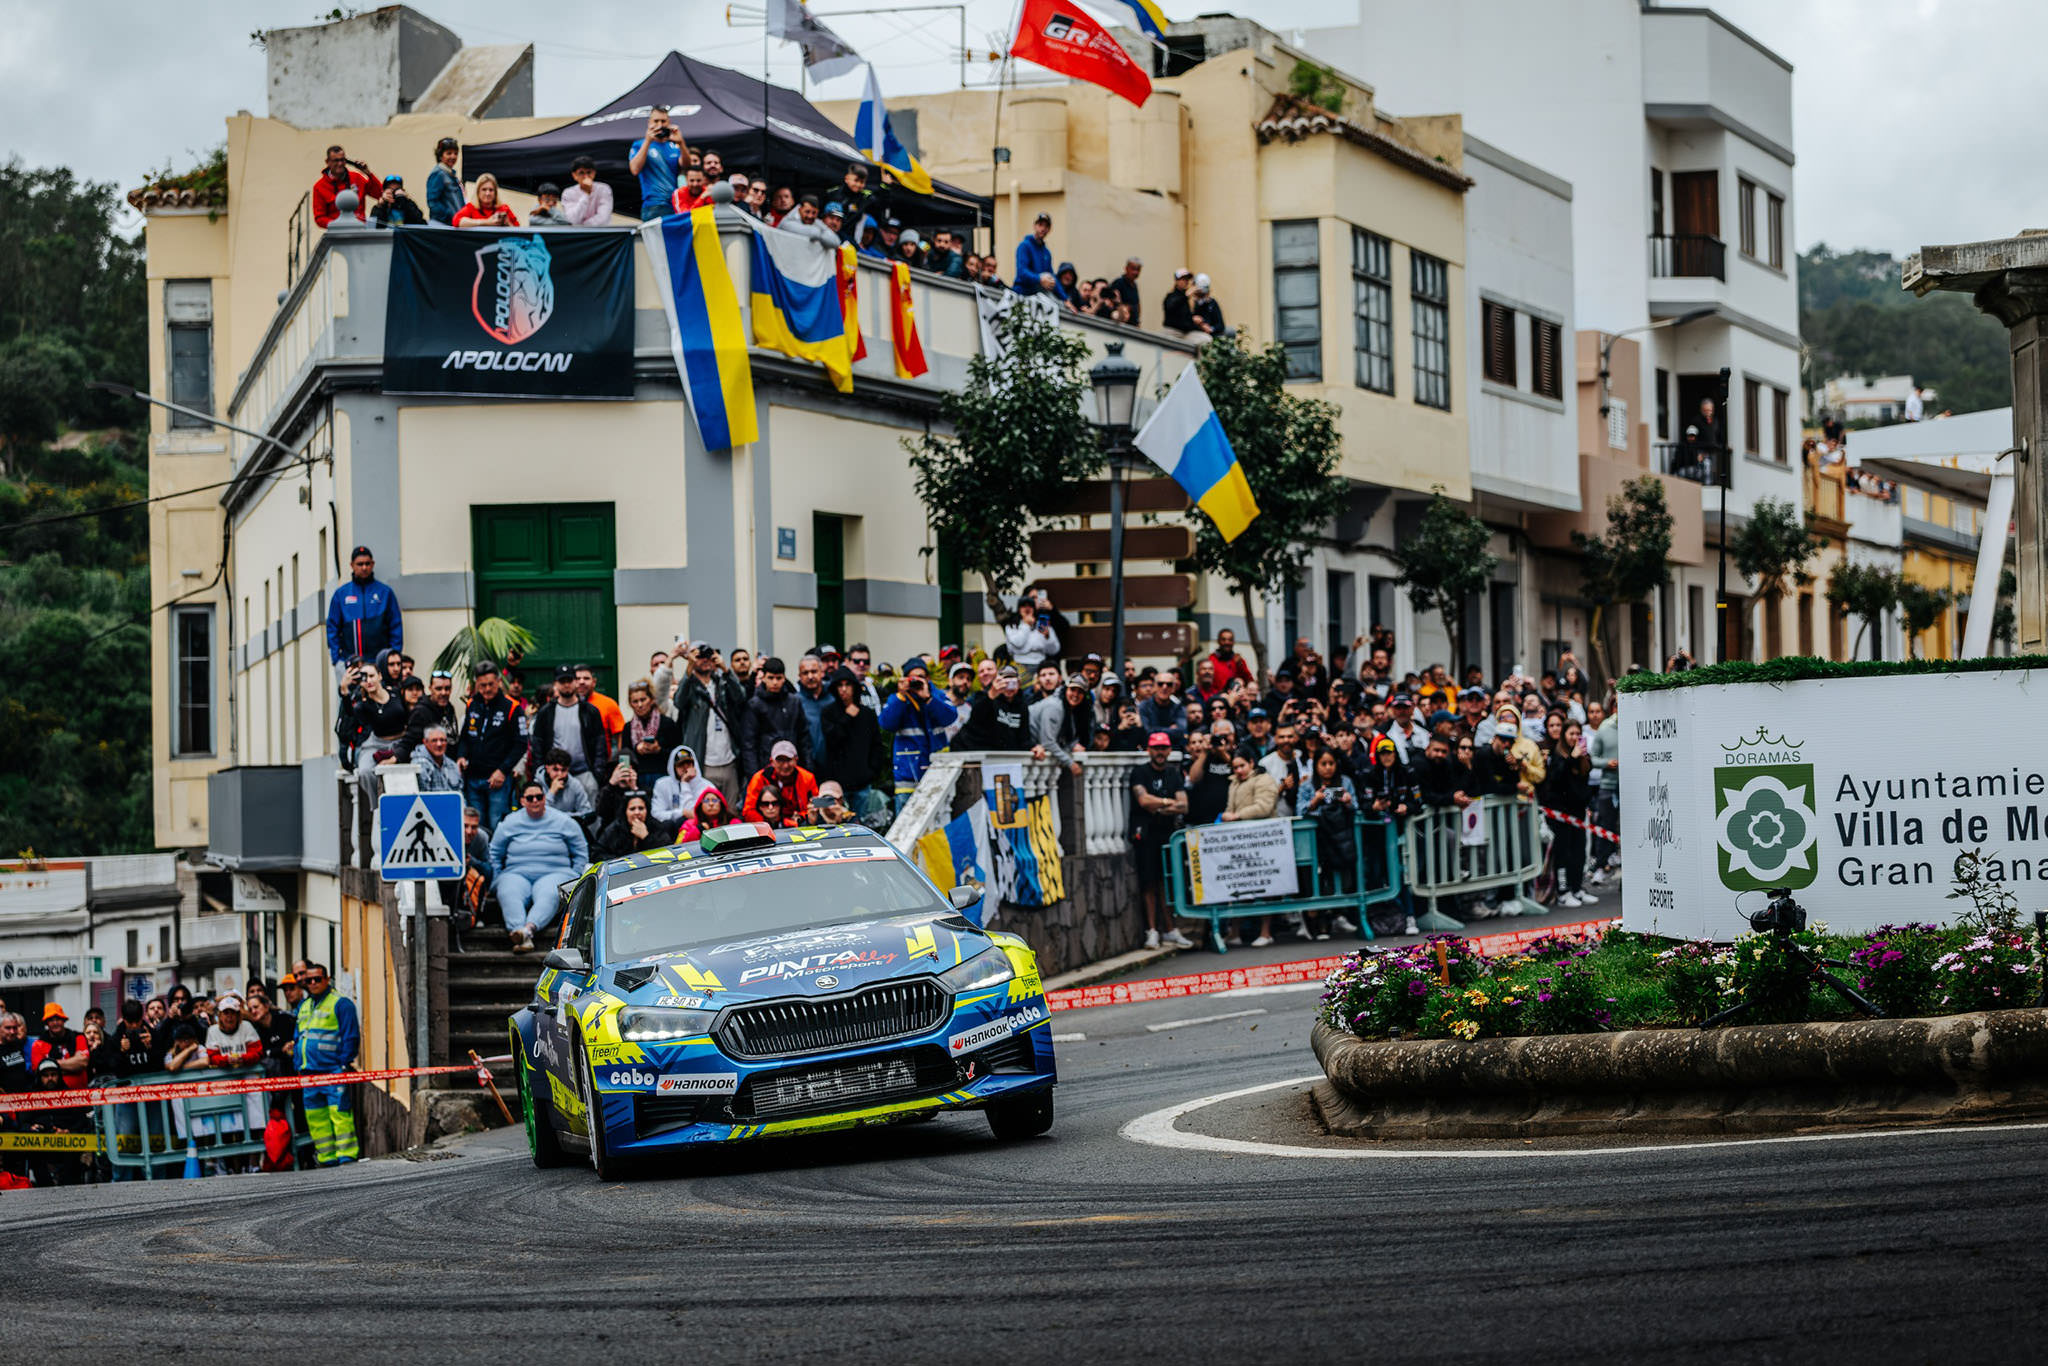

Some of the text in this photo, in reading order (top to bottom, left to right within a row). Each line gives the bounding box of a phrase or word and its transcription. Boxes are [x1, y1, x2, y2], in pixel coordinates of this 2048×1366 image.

[1045, 21, 1090, 46] GR
[442, 350, 573, 372] APOLOCAN
[1636, 718, 1677, 740] VILLA DE MOYA
[1725, 750, 1801, 765] DORAMAS
[1834, 805, 2048, 847] Villa de M
[666, 847, 875, 885] FORUM8
[1191, 850, 1203, 884] AVISO
[1838, 856, 1934, 887] Gran
[1649, 888, 1674, 909] DEPORTE
[17, 962, 78, 978] autoescuela
[739, 950, 860, 984] PINTA
[782, 960, 883, 981] Motorsport
[1007, 1006, 1041, 1028] cabo
[592, 1045, 620, 1060] freem
[610, 1069, 655, 1086] cabo
[13, 1136, 41, 1148] ZONA
[43, 1136, 87, 1148] PUBLICO
